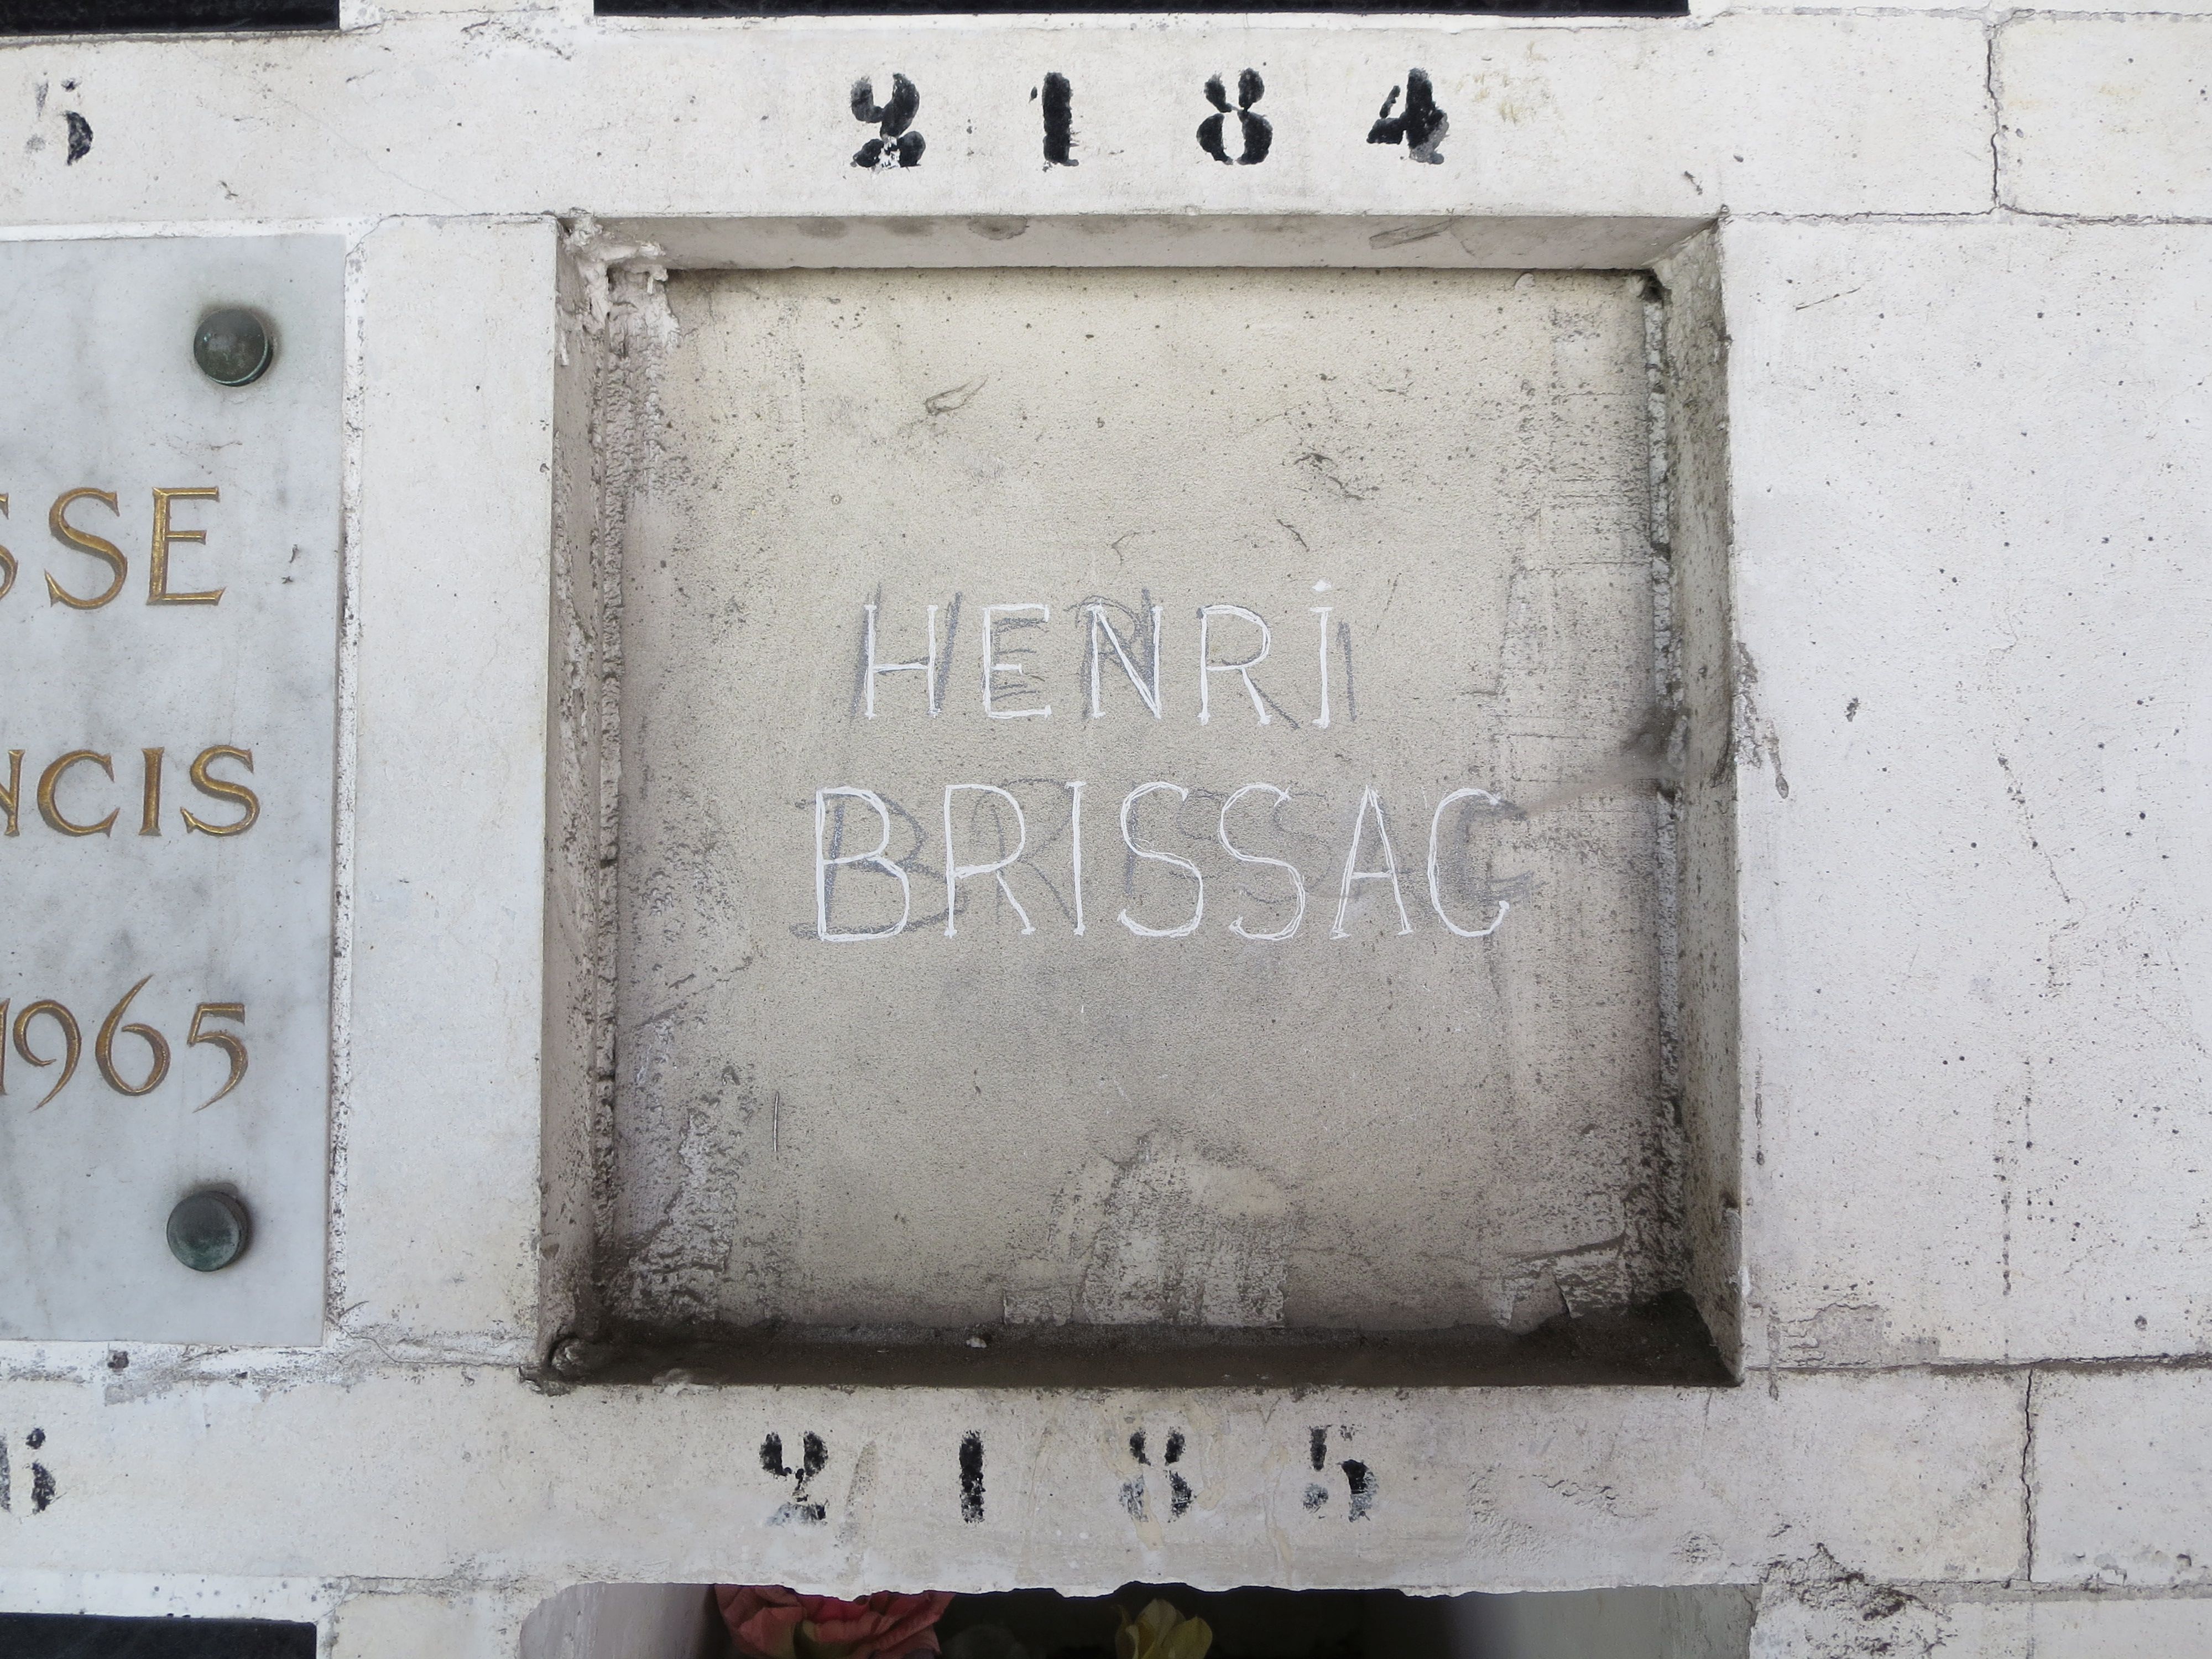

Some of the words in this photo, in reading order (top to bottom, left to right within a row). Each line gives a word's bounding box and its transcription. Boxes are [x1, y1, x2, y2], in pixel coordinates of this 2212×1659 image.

[851, 67, 1449, 169] 2184
[0, 487, 226, 609] SE
[815, 780, 1510, 942] BRISSAC
